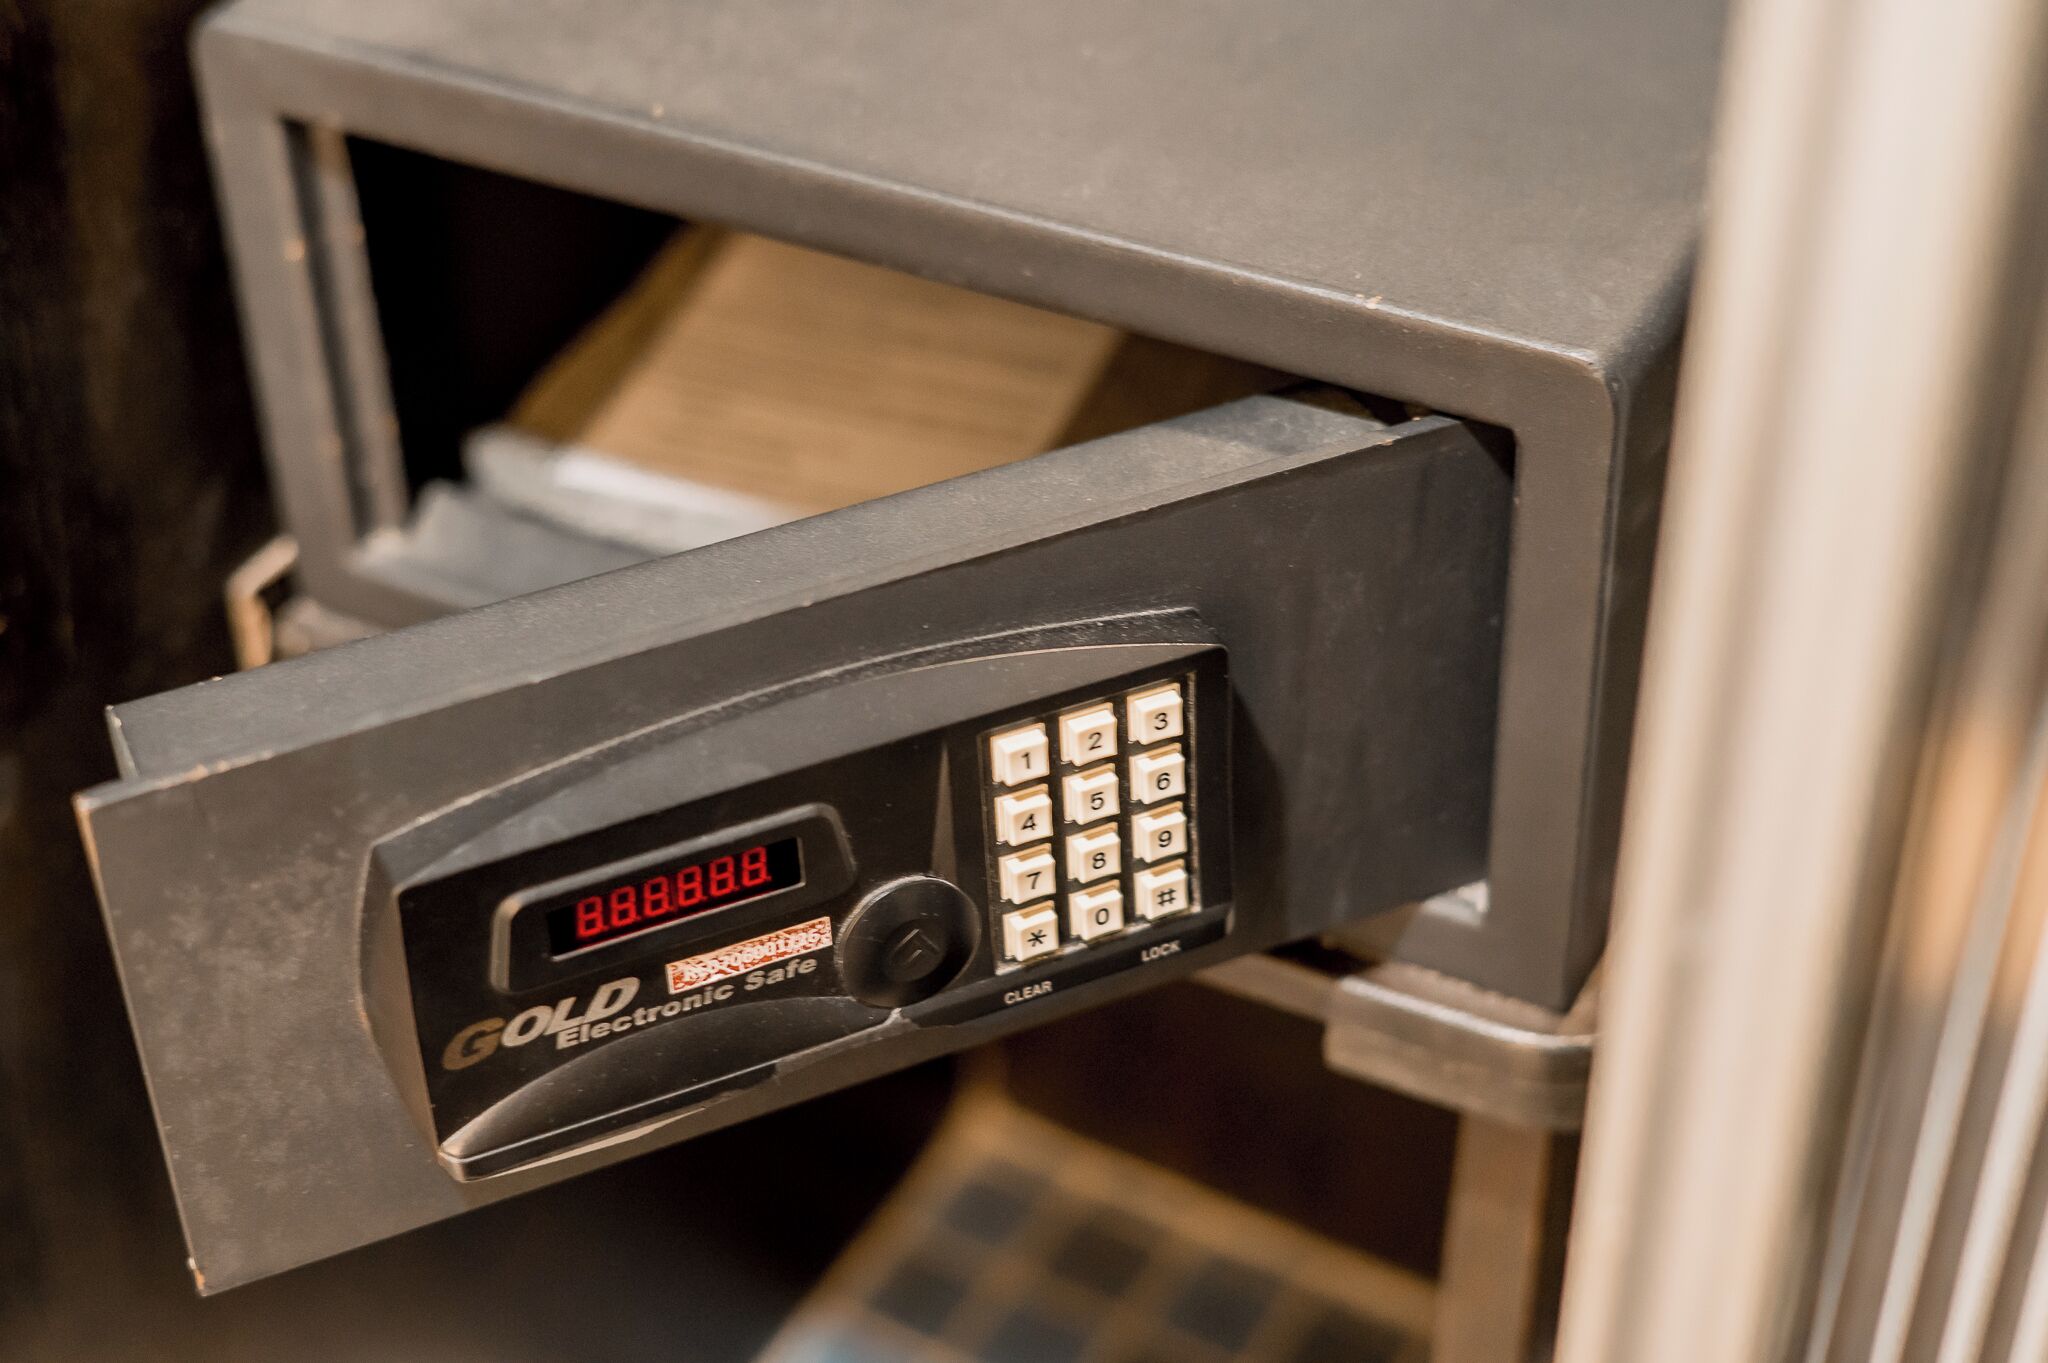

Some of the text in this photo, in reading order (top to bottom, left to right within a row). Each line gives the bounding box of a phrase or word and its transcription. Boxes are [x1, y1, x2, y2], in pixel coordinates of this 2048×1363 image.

[1021, 712, 1168, 770] 1 2 3
[1022, 772, 1170, 831] 4 5 6
[1027, 831, 1172, 890] 7 8 9
[1096, 907, 1109, 925] 0
[1157, 888, 1176, 906] #
[1142, 940, 1181, 962] LOCK
[556, 984, 734, 1051] Electronic
[744, 956, 817, 991] Safe
[1004, 981, 1052, 1005] CLEAR
[441, 976, 639, 1070] GOLD
